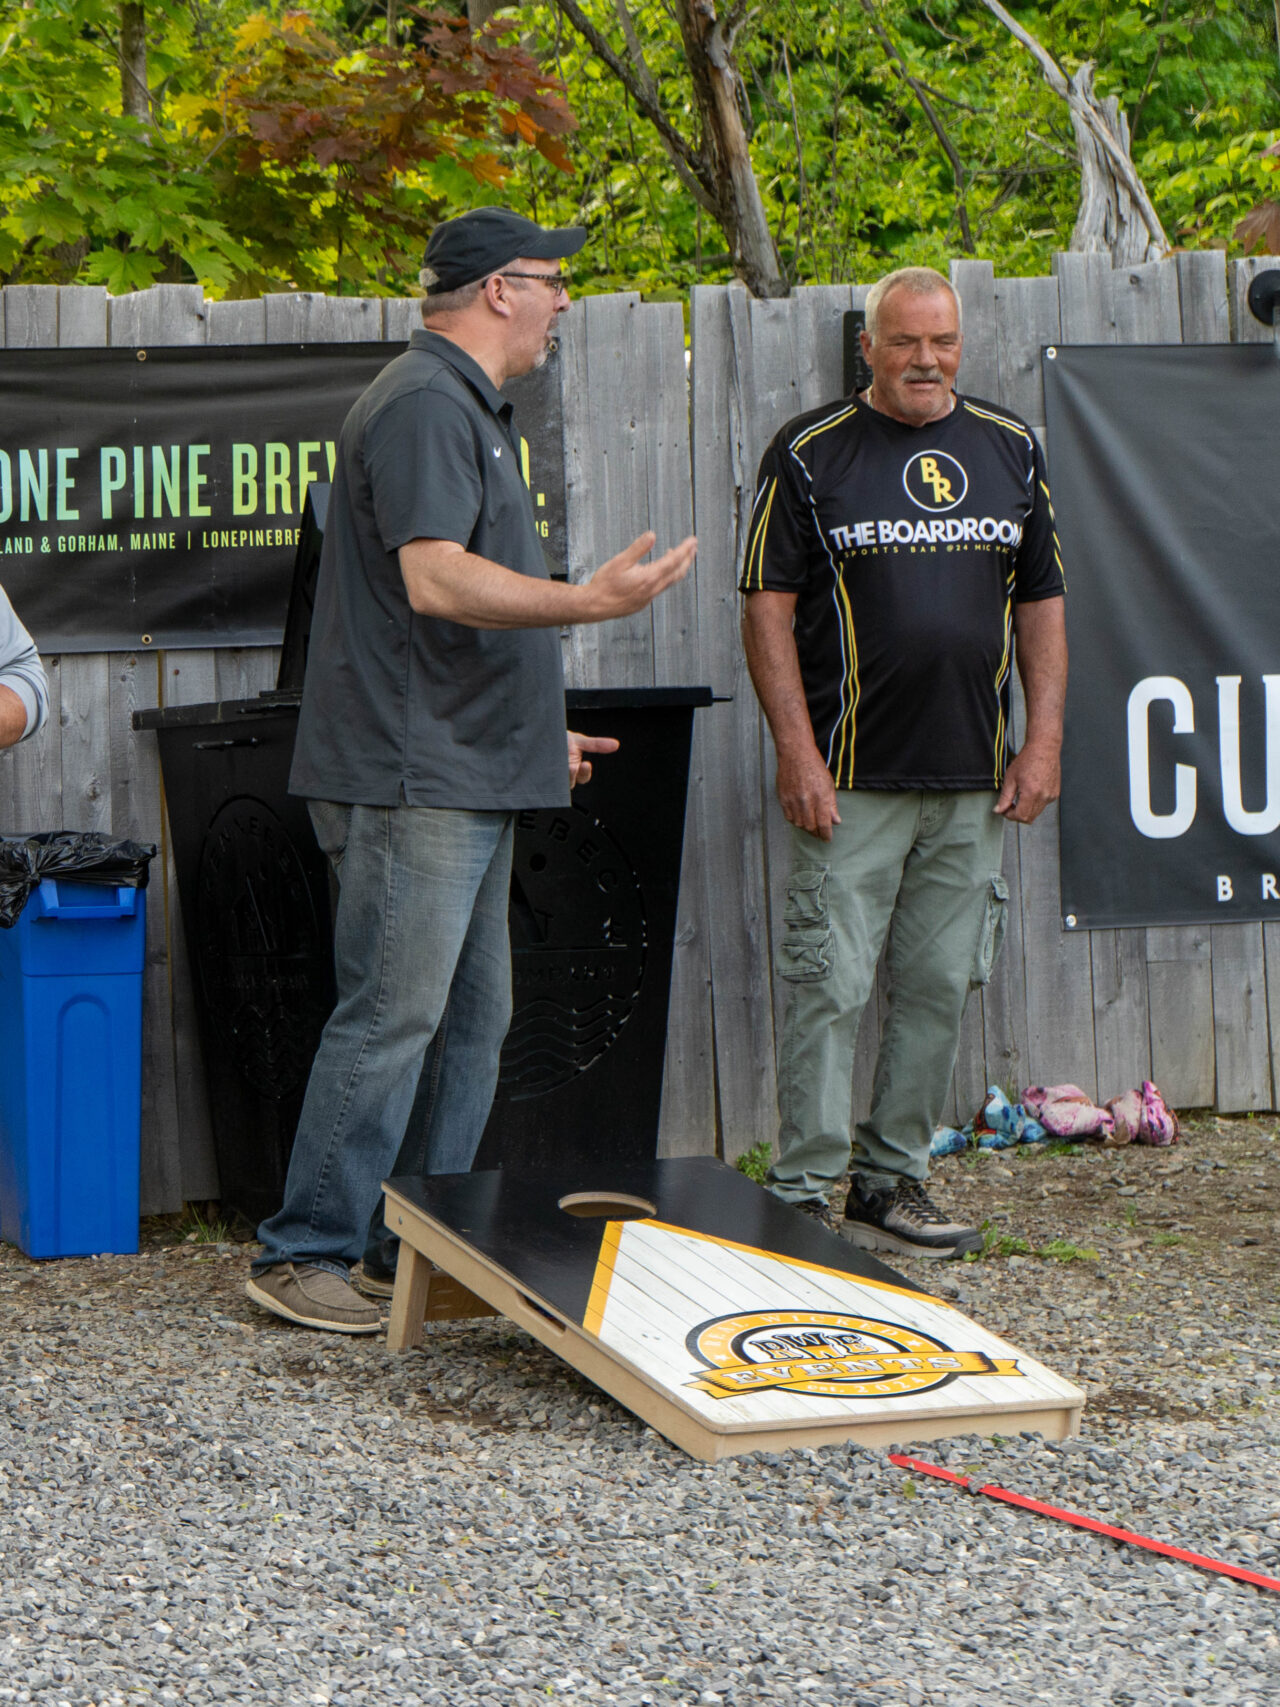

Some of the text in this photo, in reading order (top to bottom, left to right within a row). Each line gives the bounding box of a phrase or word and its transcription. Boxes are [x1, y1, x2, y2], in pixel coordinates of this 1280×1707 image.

[100, 444, 212, 519] PINE
[232, 441, 337, 515] BRE
[40, 536, 51, 553] &
[57, 534, 124, 552] GORHAM,
[130, 532, 176, 550] MAINE
[910, 545, 937, 554] BAR
[720, 1356, 964, 1385] EVENTS
